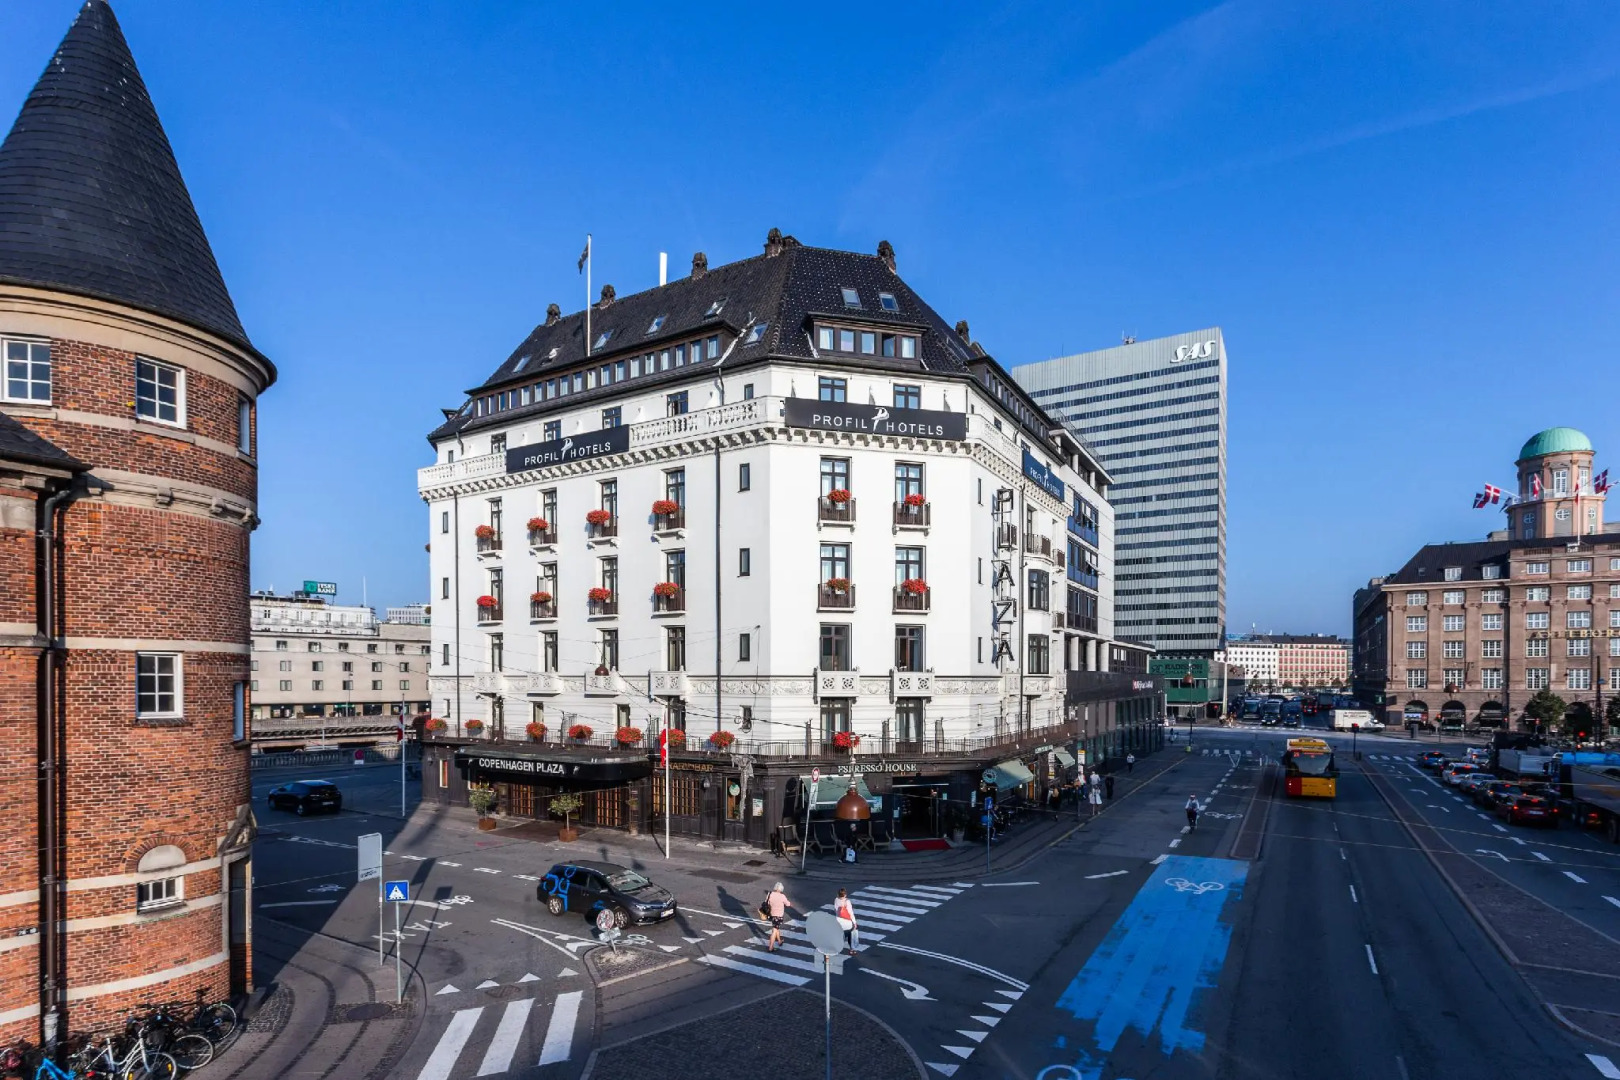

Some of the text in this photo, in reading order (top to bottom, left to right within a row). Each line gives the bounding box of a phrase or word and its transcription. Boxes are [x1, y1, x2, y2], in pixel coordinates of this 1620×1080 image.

[1170, 340, 1216, 363] SAS
[812, 414, 944, 436] PROFIL HOTELS
[524, 441, 611, 466] PROFIL HOTELS
[995, 488, 1016, 661] PLAZA
[479, 758, 565, 775] COPENHAGEN PLAZA
[695, 763, 714, 772] BAR
[885, 763, 917, 772] HOUSE
